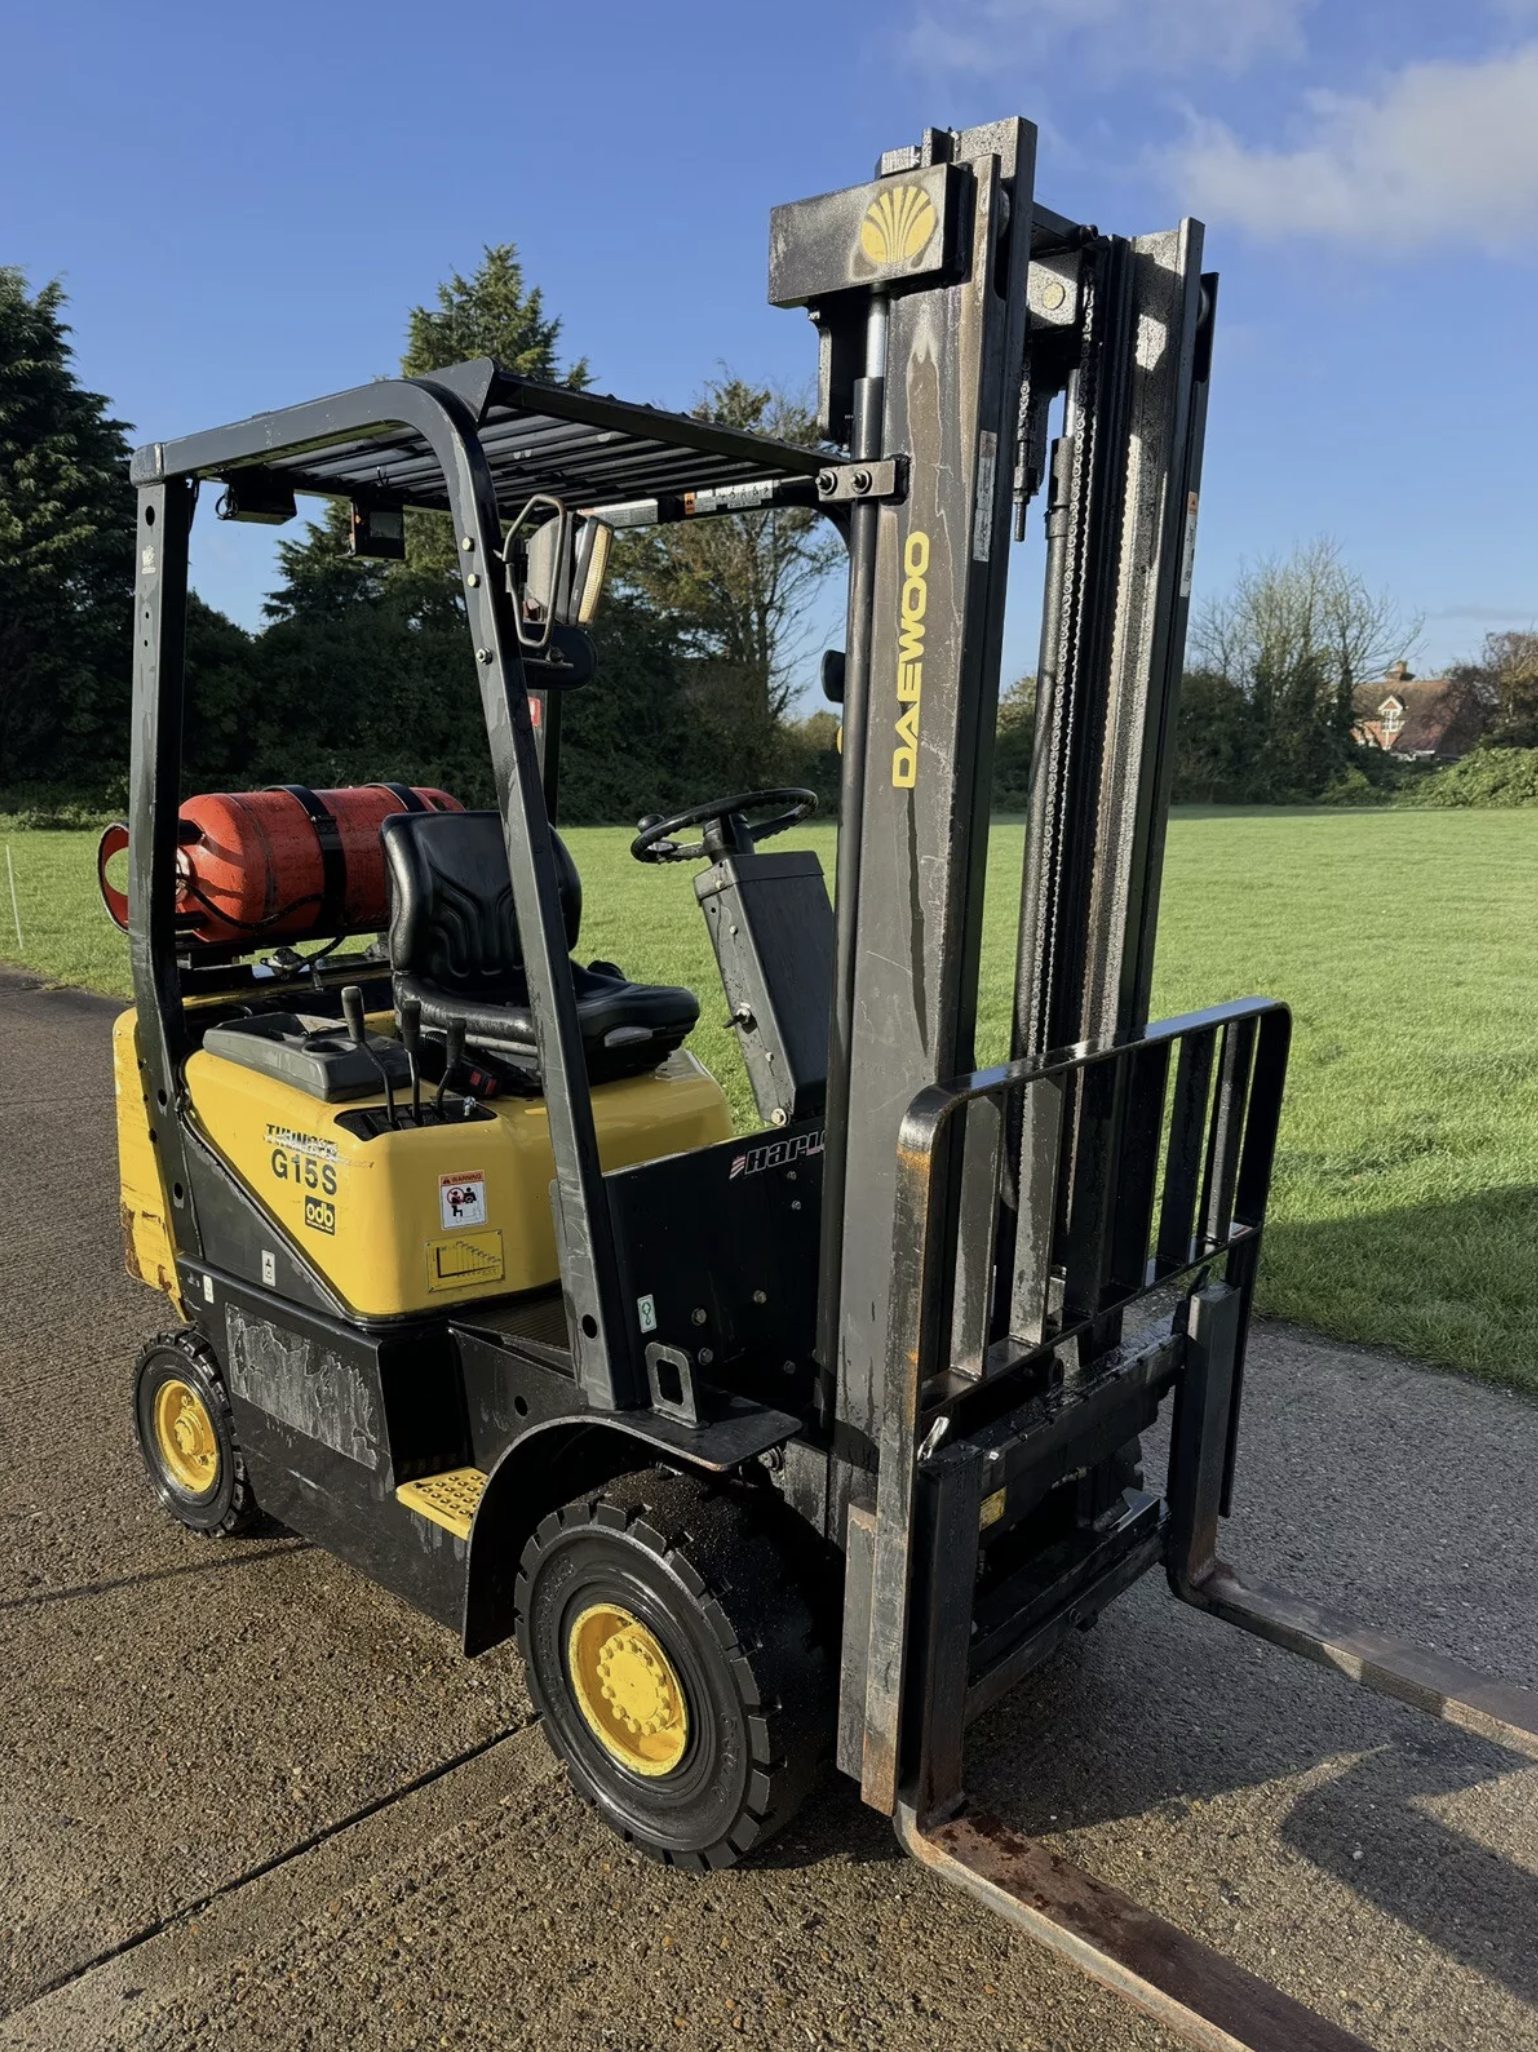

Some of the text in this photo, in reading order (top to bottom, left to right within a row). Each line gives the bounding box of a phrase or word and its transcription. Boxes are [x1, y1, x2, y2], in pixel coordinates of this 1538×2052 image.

[892, 531, 930, 788] DAEWOO
[271, 1148, 338, 1196] G15S
[451, 1172, 483, 1183] WARNING
